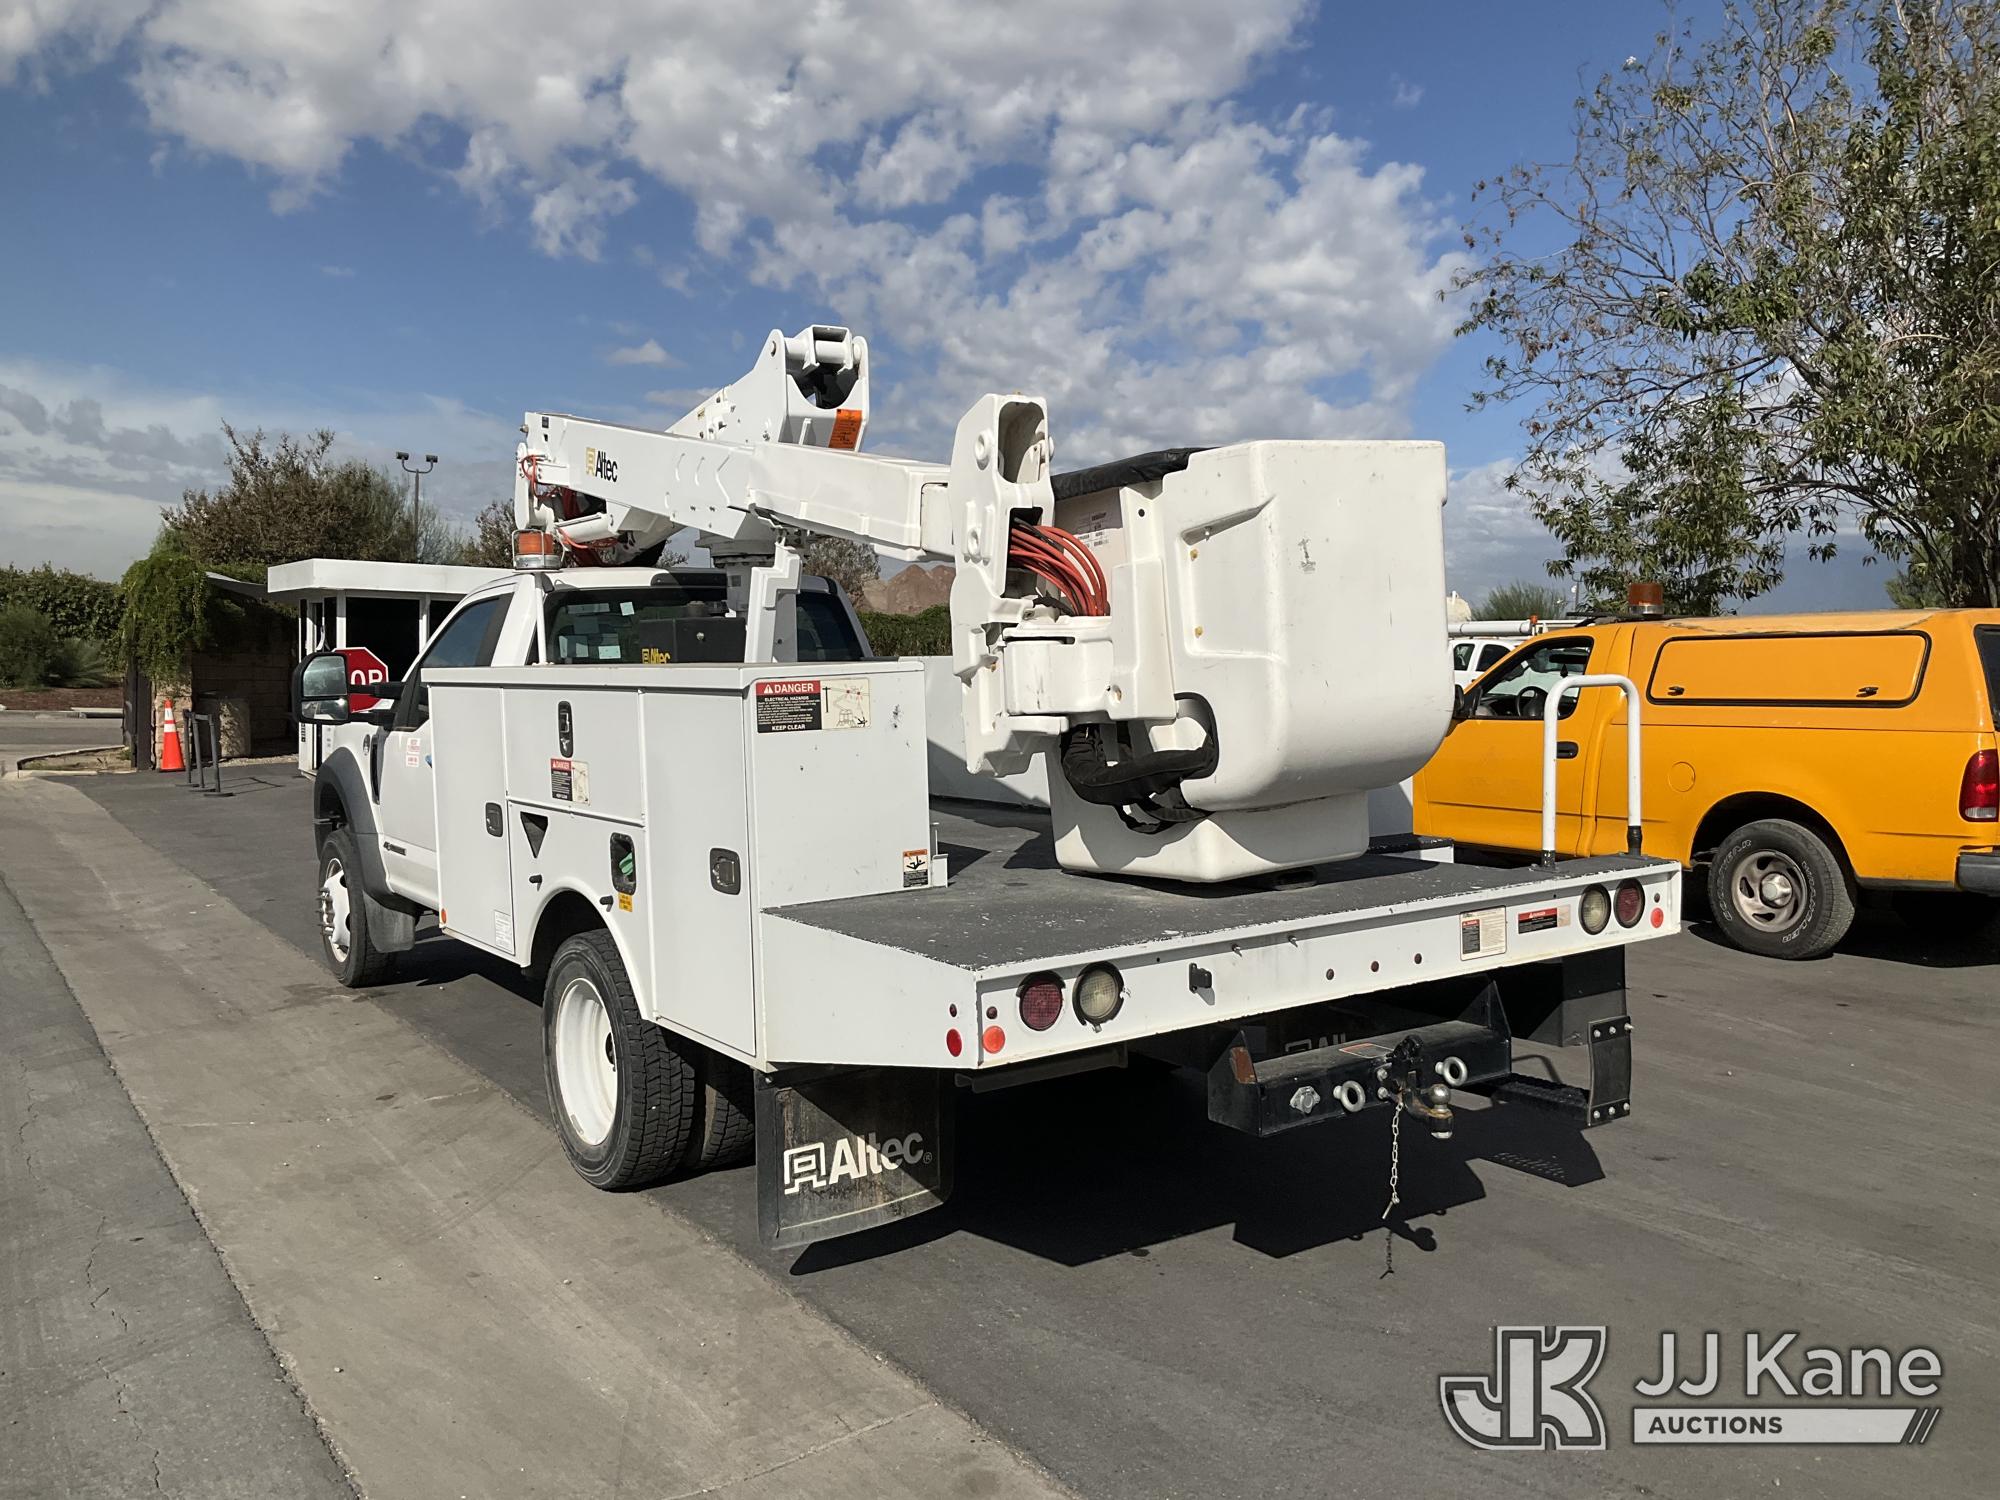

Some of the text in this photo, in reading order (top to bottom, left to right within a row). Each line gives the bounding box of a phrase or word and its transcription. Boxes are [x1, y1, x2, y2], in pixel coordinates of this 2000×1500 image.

[595, 450, 618, 482] Altec
[350, 669, 383, 686] OP
[774, 683, 814, 694] DANGER
[828, 1132, 924, 1185] Altec
